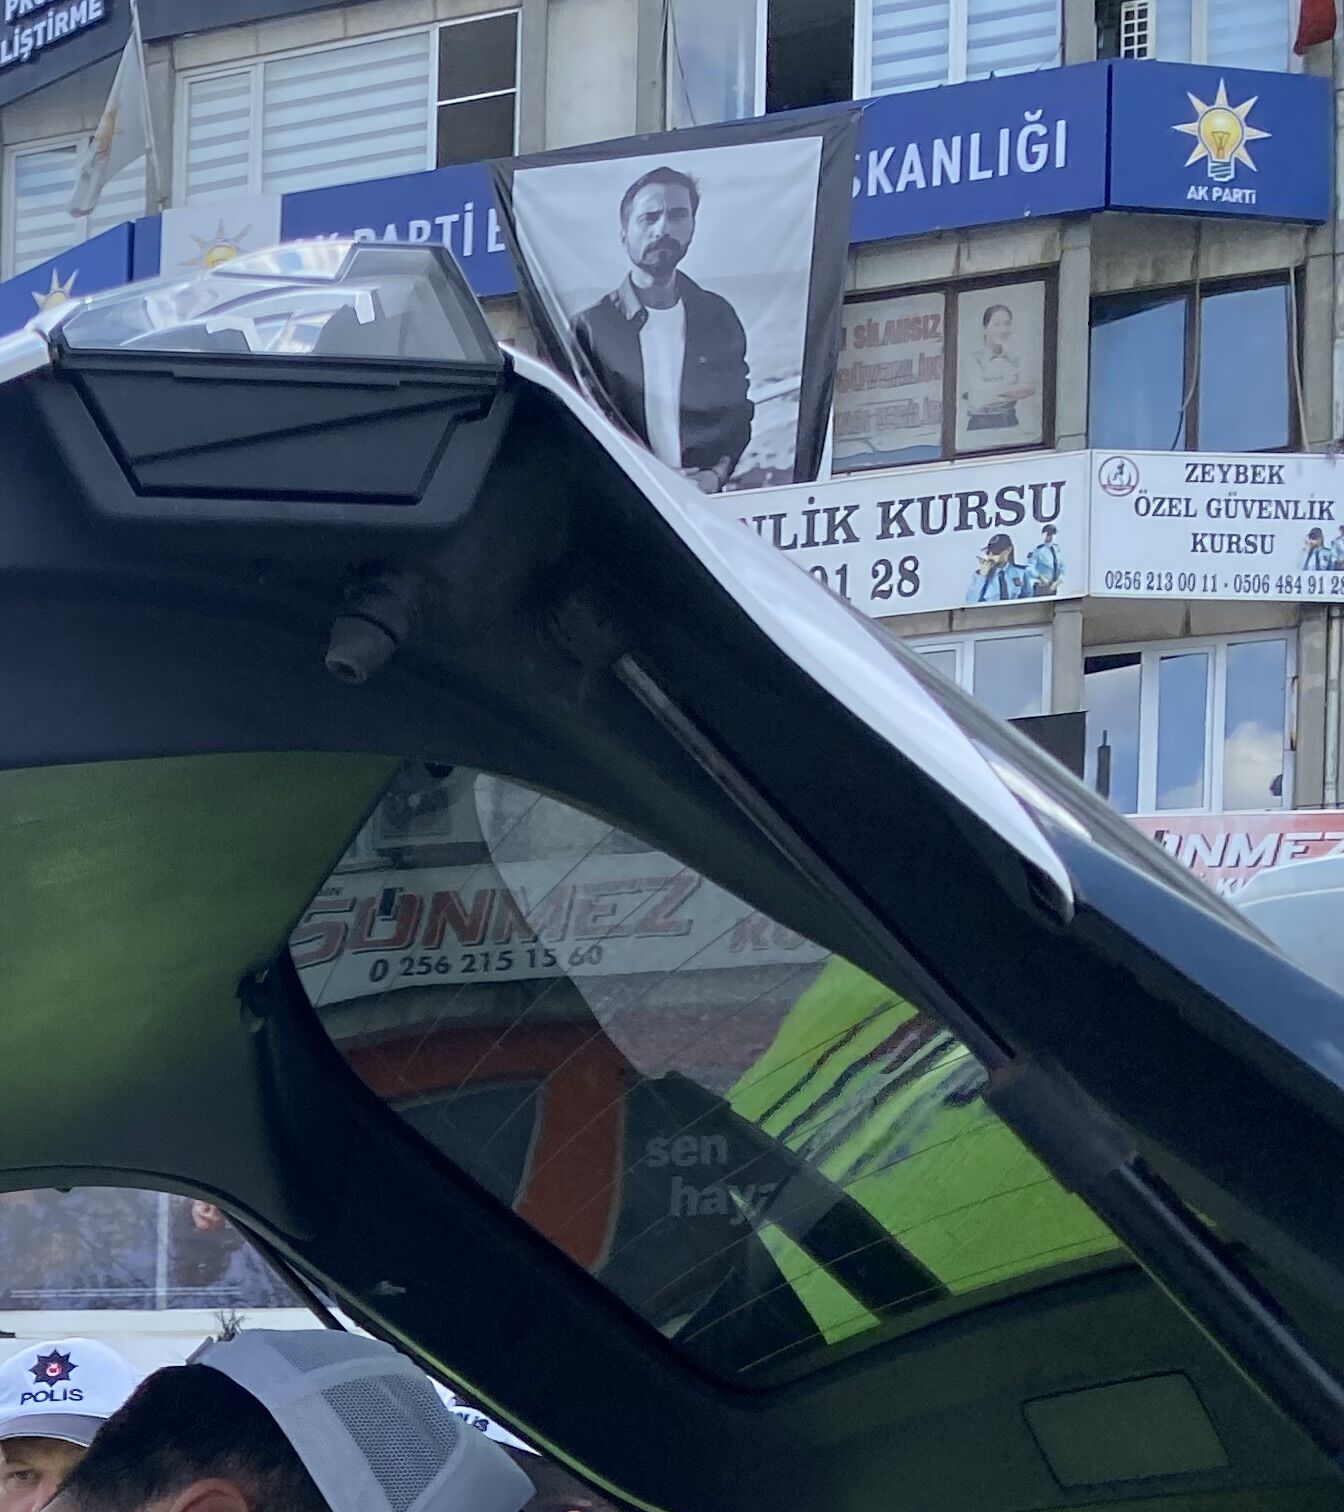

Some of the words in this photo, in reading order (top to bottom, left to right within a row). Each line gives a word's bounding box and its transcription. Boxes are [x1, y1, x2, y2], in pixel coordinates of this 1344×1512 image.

[1186, 185, 1210, 202] AK
[1185, 463, 1286, 485] ZEYBEK
[876, 480, 1066, 541] KURSU
[1134, 489, 1198, 518] ÖZEL
[1206, 491, 1336, 521] GÜVENLİK
[1191, 532, 1276, 555] KURSU
[872, 555, 921, 601] 28
[1105, 570, 1141, 590] 0256
[1146, 571, 1174, 591] 213
[1178, 572, 1196, 592] 00
[1202, 573, 1218, 592] 11
[1233, 574, 1271, 594] 0506
[1275, 575, 1302, 594] 484
[1308, 576, 1325, 595] 91
[368, 958, 390, 983] 0
[399, 955, 451, 977] 256
[460, 950, 513, 973] 215
[526, 949, 557, 968] 15
[568, 944, 603, 966] 60
[644, 1134, 728, 1167] sen
